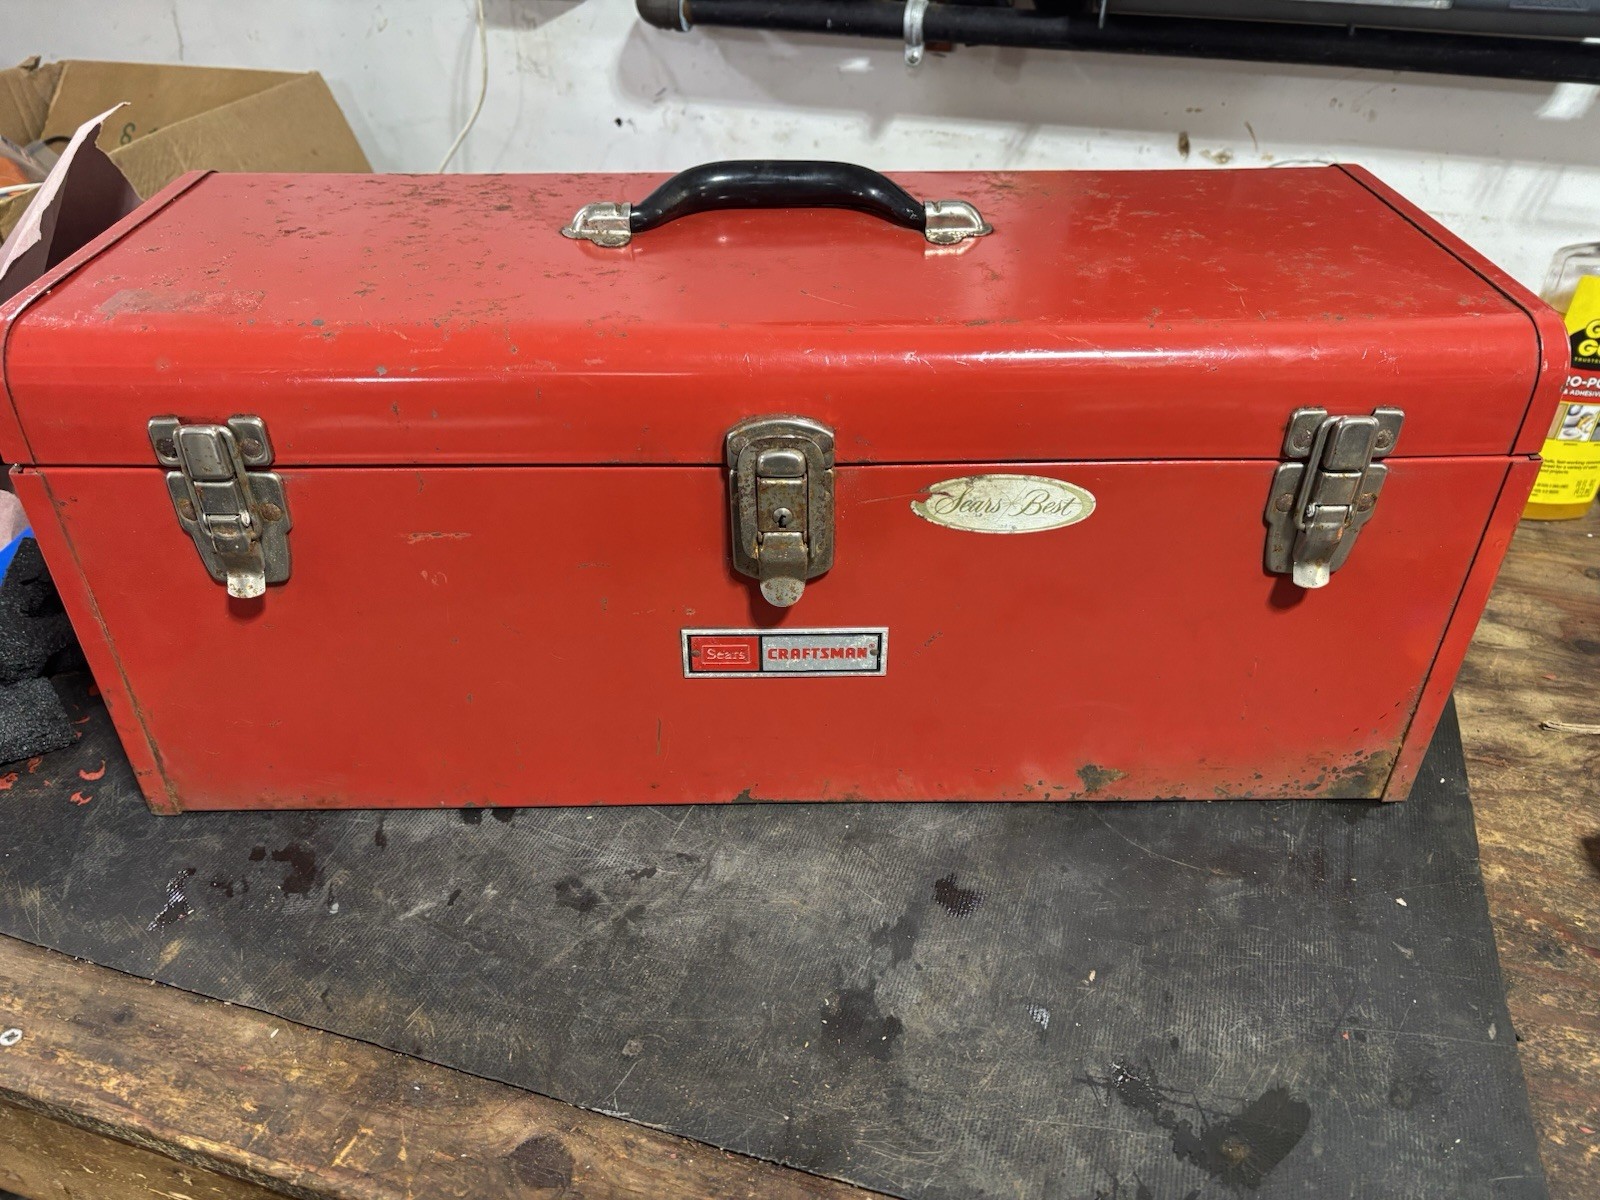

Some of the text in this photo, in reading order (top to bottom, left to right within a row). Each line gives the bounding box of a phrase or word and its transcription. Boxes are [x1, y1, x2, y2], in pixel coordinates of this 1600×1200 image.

[1578, 338, 1600, 357] G
[934, 487, 1077, 517] Sears Best
[706, 648, 746, 660] Sears
